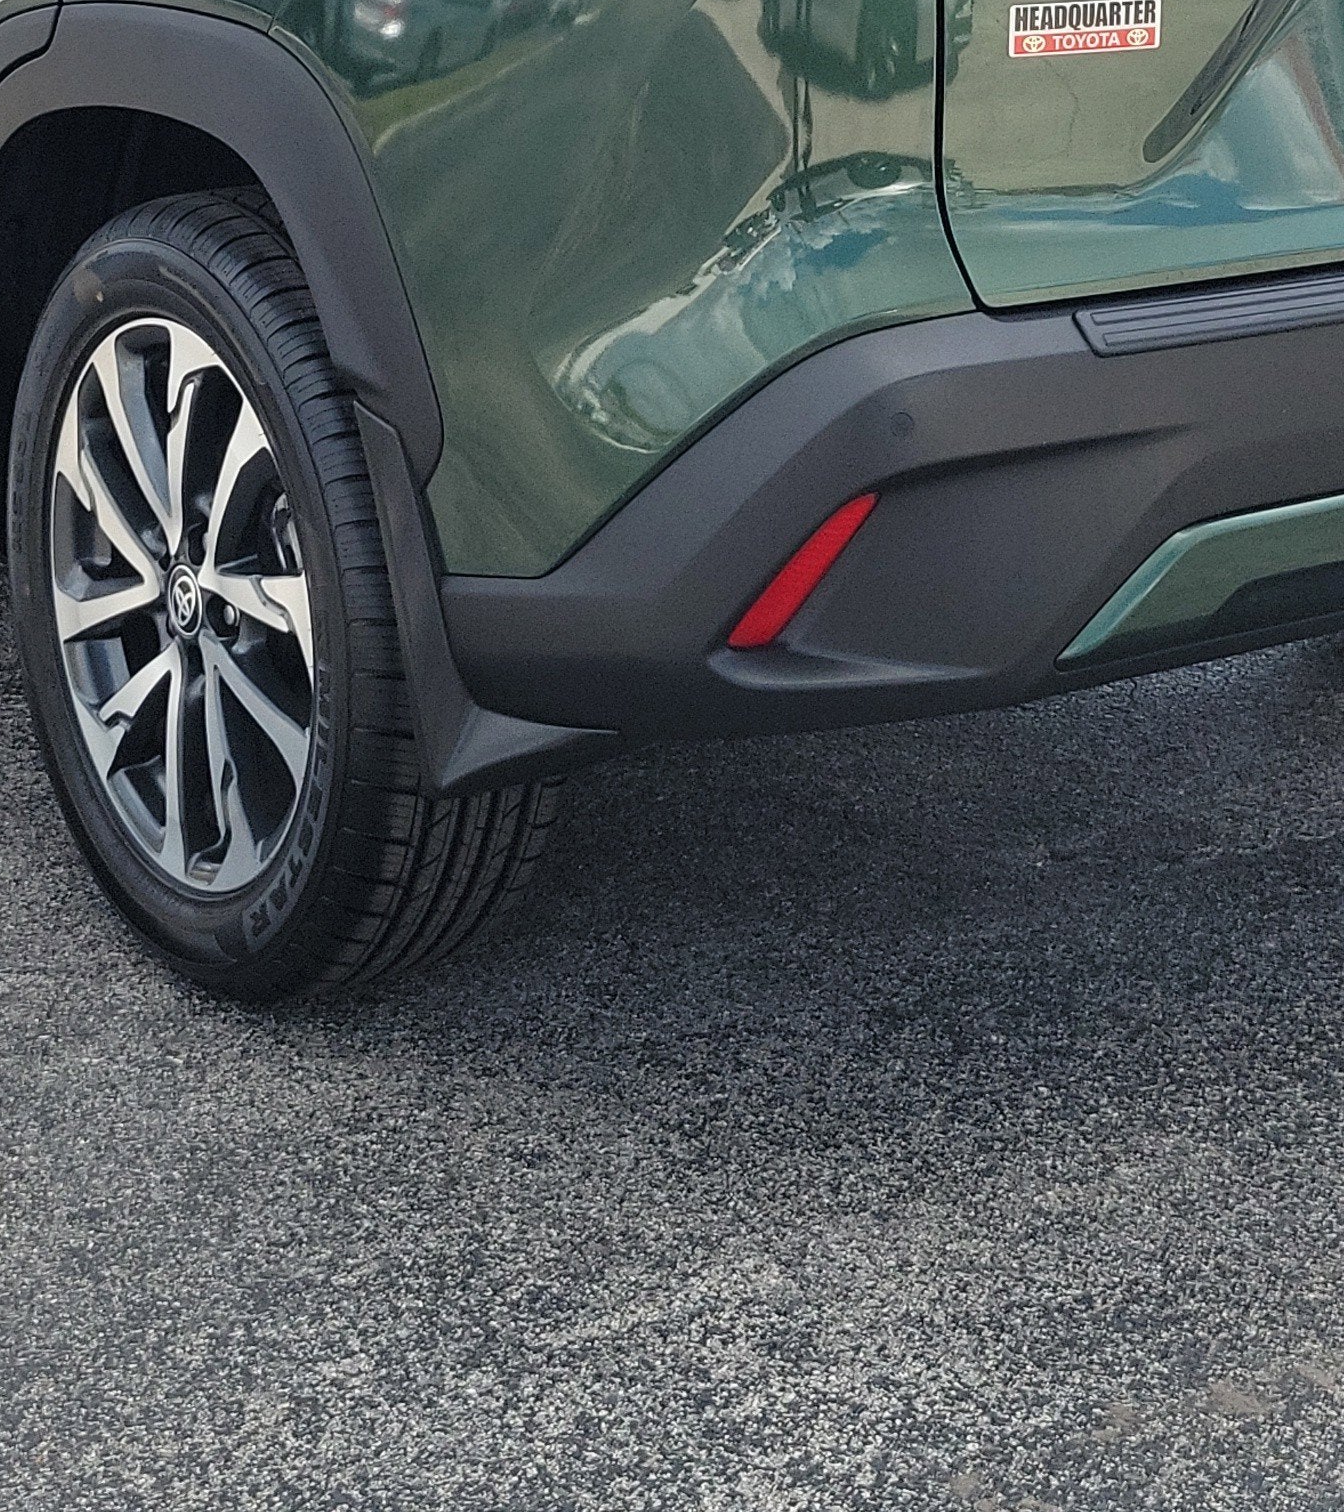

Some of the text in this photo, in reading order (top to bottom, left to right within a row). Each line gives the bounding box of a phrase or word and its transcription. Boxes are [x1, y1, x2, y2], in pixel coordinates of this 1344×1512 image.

[1014, 0, 1156, 32] HEADQUARTER
[1052, 31, 1120, 50] TOYOTA
[247, 660, 333, 941] MILESTAR
